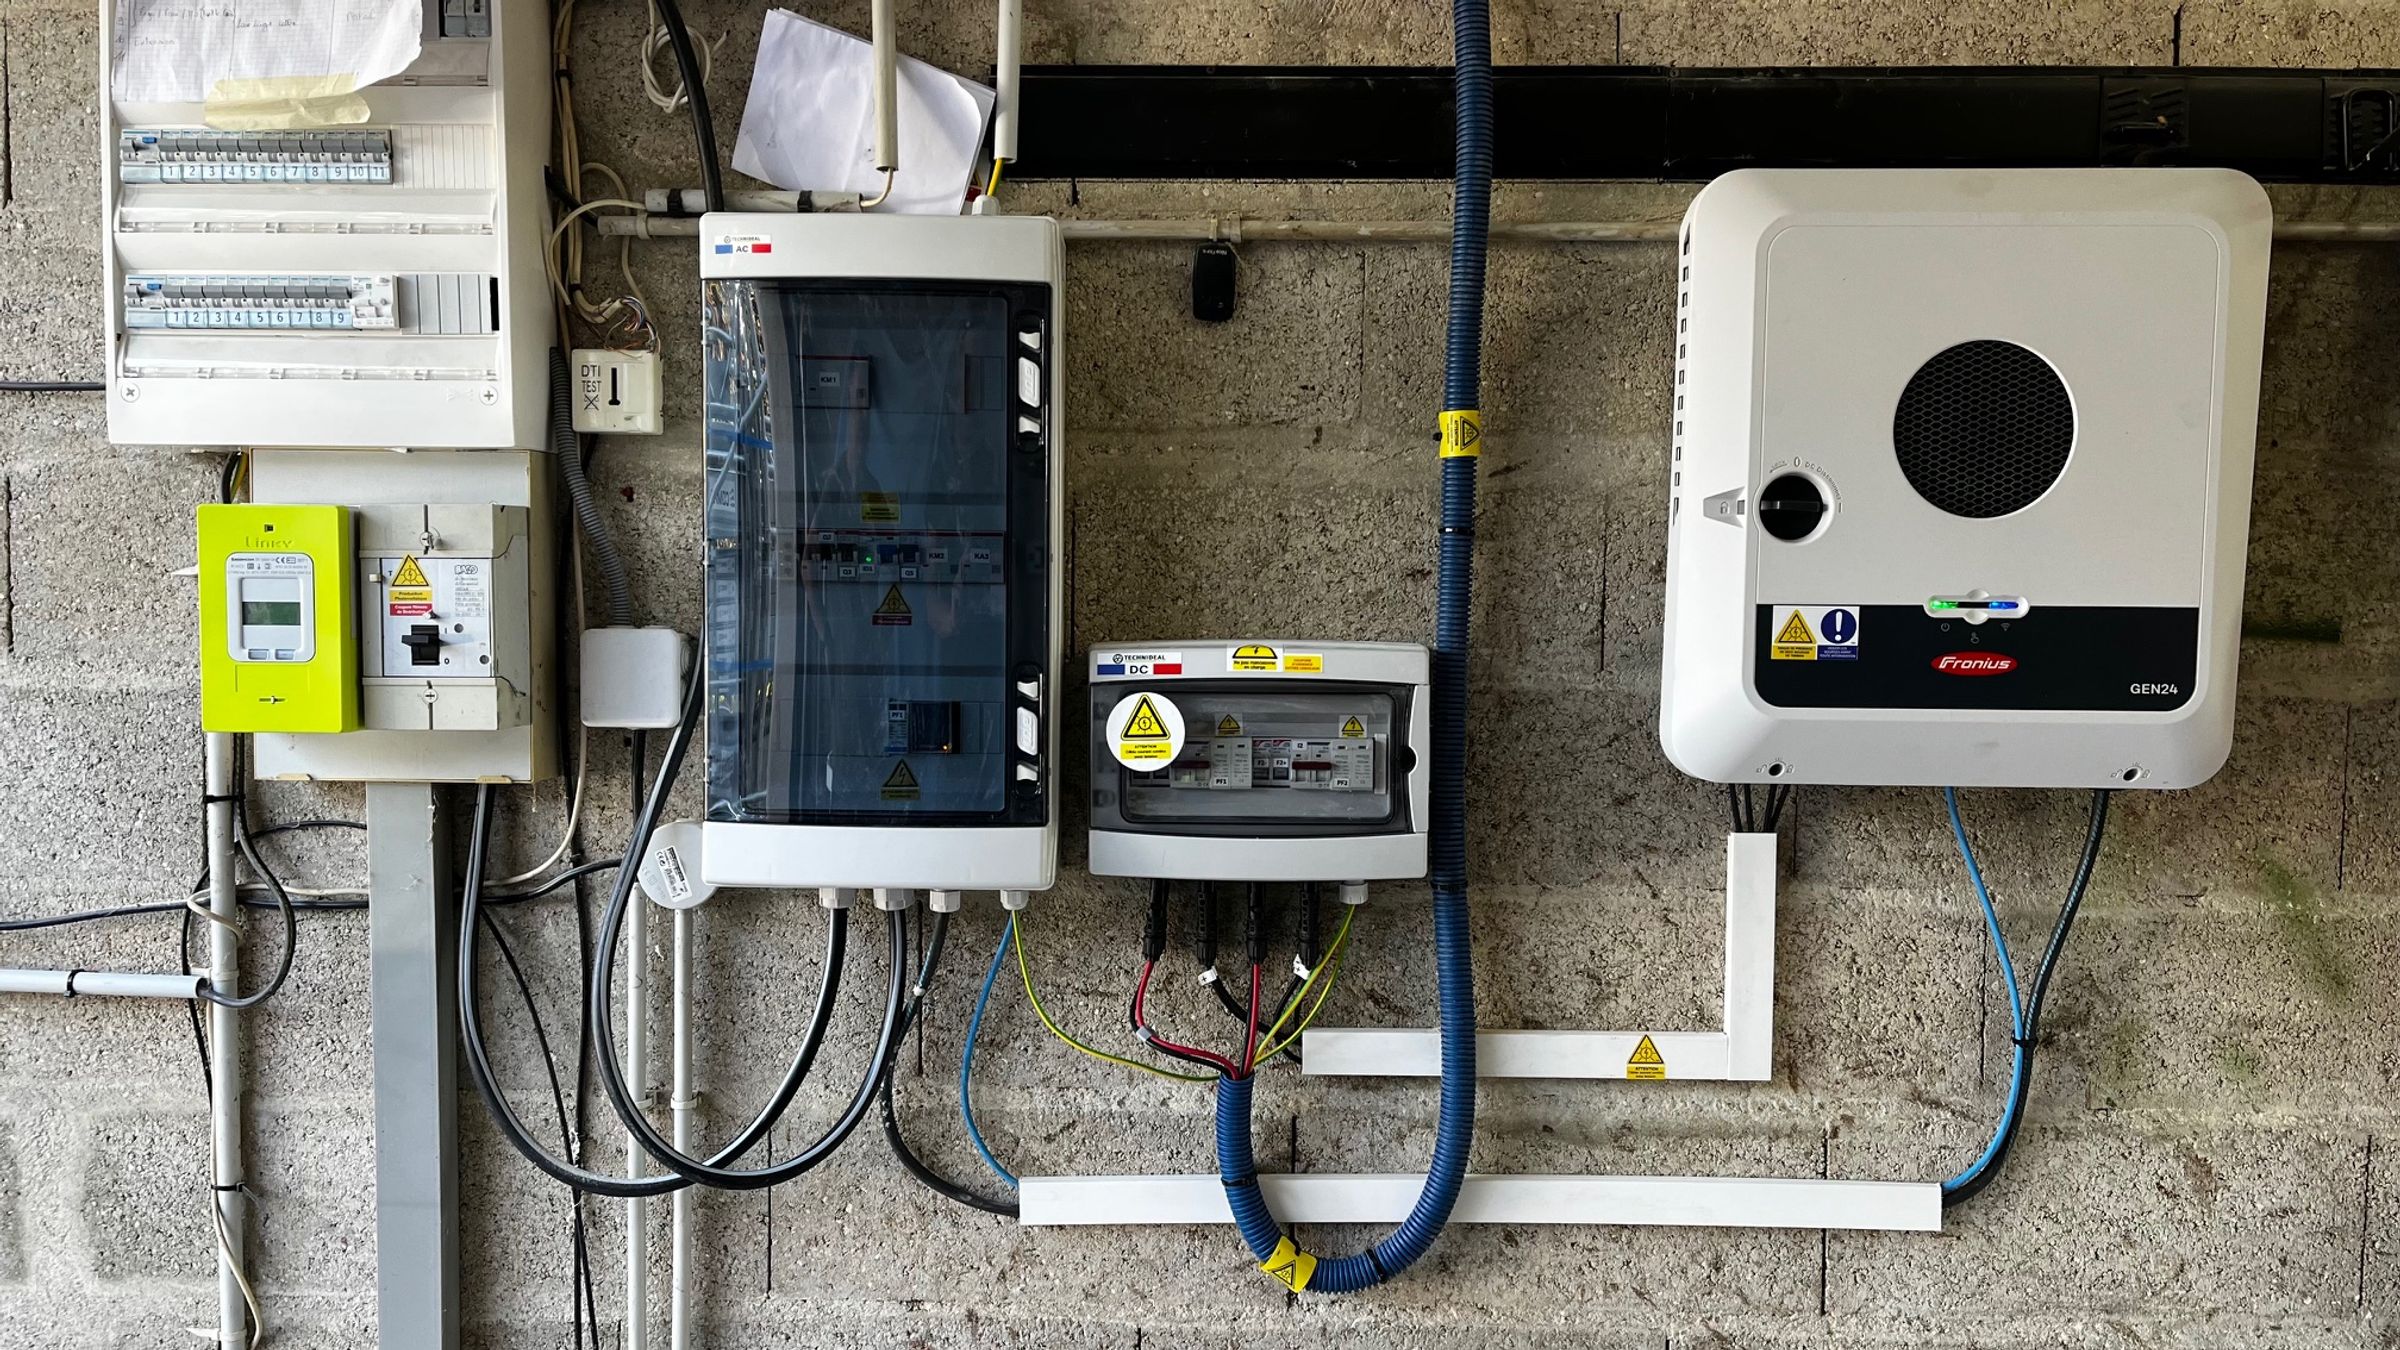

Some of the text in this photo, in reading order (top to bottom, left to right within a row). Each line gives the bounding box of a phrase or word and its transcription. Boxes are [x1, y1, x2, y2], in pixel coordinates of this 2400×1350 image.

[169, 166, 386, 177] 1 2 3 4 5 6 7 8 9 10 11
[736, 245, 748, 253] AC
[173, 312, 344, 323] 1 2 3 4 5 6 7 8 9
[581, 364, 601, 377] DTI
[582, 380, 602, 392] TEST
[1938, 656, 2012, 670] Fronius
[1130, 665, 1148, 674] DC
[2130, 683, 2179, 695] GEN24
